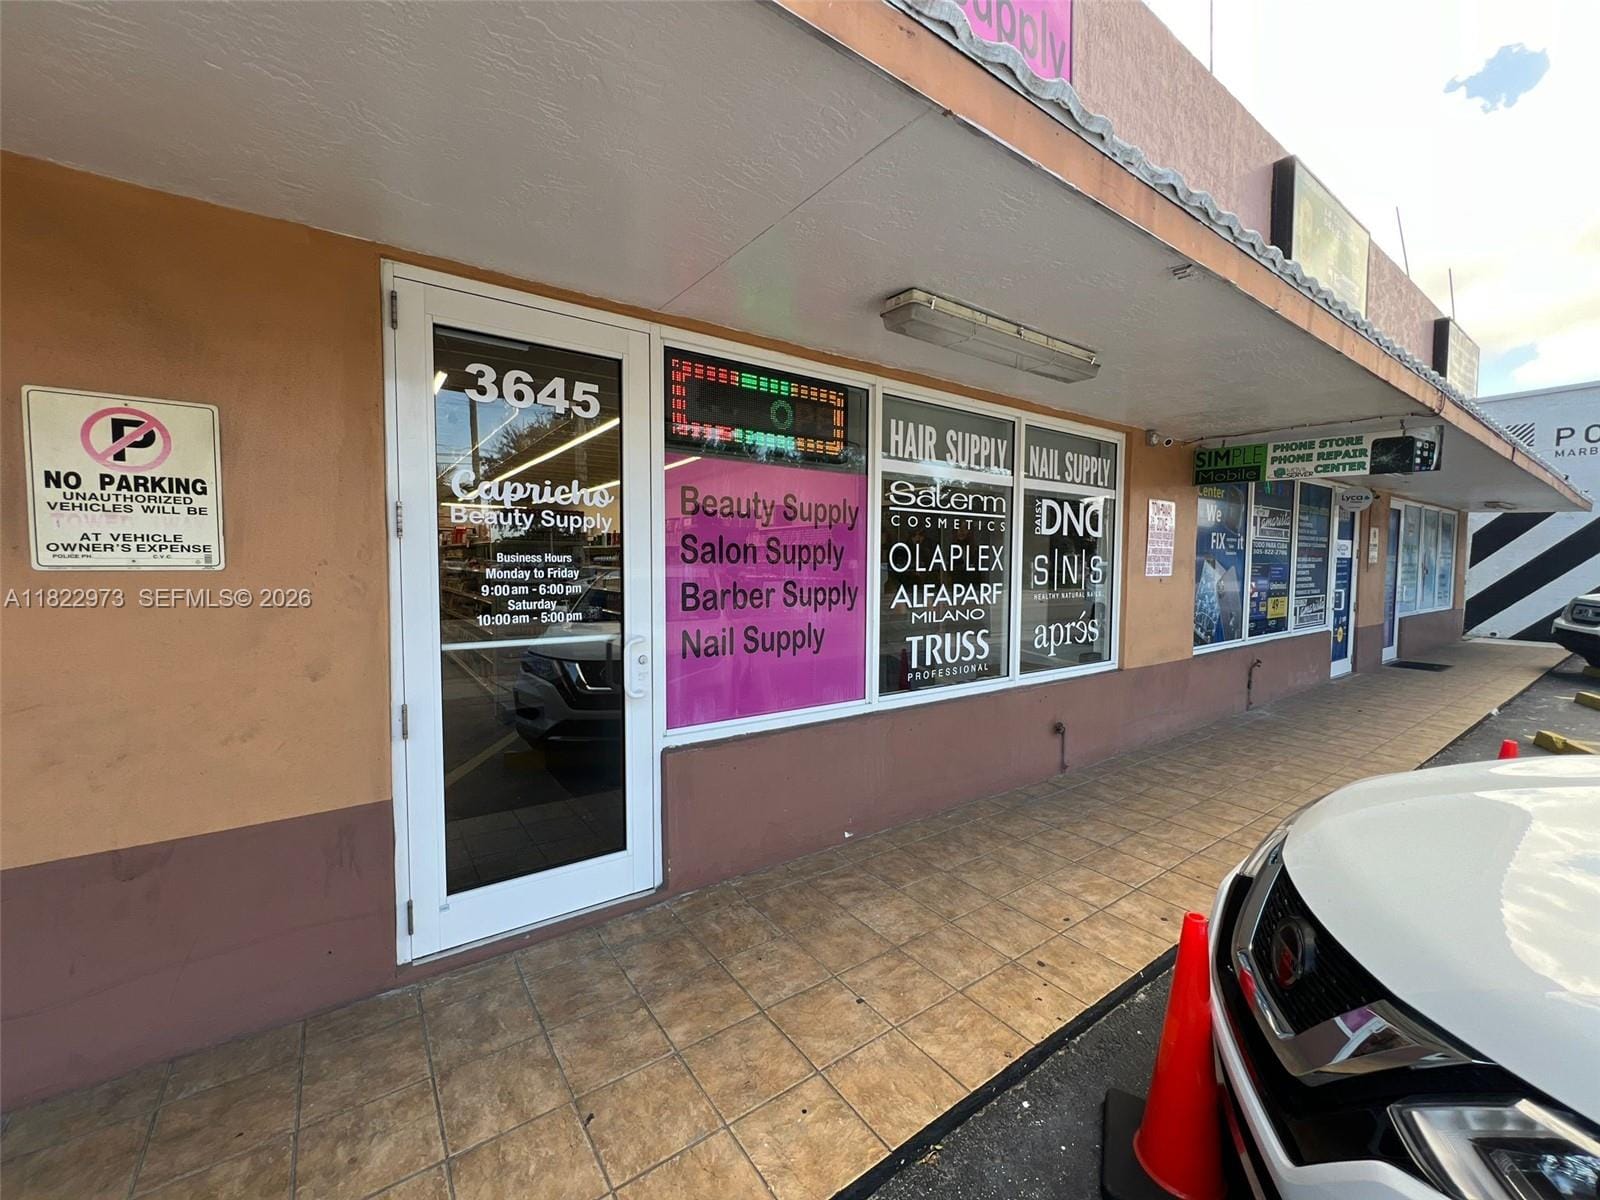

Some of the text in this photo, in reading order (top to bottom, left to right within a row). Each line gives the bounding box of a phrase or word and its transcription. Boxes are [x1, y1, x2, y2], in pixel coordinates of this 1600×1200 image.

[956, 0, 1065, 77] upply
[464, 363, 601, 419] 3645
[890, 418, 1008, 471] HAIR SUPPLY
[1273, 435, 1364, 453] PHONE STORE
[1554, 446, 1599, 458] MARB
[1196, 445, 1262, 468] SIMPLE
[1270, 448, 1368, 465] PHONE REPAIR
[1029, 445, 1111, 487] NAIL SUPPLY
[1314, 461, 1367, 473] CENTER
[43, 471, 208, 496] NO PARKING
[1199, 469, 1257, 482] Mobile
[451, 469, 615, 508] Capricho
[63, 491, 194, 505] UNAUTHORIZED
[46, 501, 208, 516] VEHICLES WILL BE
[680, 485, 859, 531] Beauty Supply
[1034, 499, 1042, 535] DAISY
[1206, 503, 1222, 522] We
[450, 506, 613, 534] Beauty Supply
[890, 515, 1006, 532] COSMETICS
[80, 532, 183, 543] AT VEHICLE
[1211, 532, 1226, 550] FIX
[1237, 534, 1244, 550] it
[46, 543, 213, 553] OWNER'S EXPENSE
[680, 533, 845, 572] Salon Supply
[496, 552, 573, 563] Business Hours
[889, 542, 1004, 573] OLAPLEX
[485, 567, 580, 581] Monday to Friday
[682, 580, 858, 613] Barber Supply
[890, 583, 1003, 609] ALFAPARF
[1033, 592, 1059, 600] HEALTHY
[1061, 591, 1085, 599] NATURAL
[507, 599, 557, 611] Saturday
[911, 608, 985, 624] MILANO
[682, 622, 825, 659] Nail Supply
[906, 629, 990, 669] TRUSS
[907, 664, 989, 682] PROFESSIONAL
